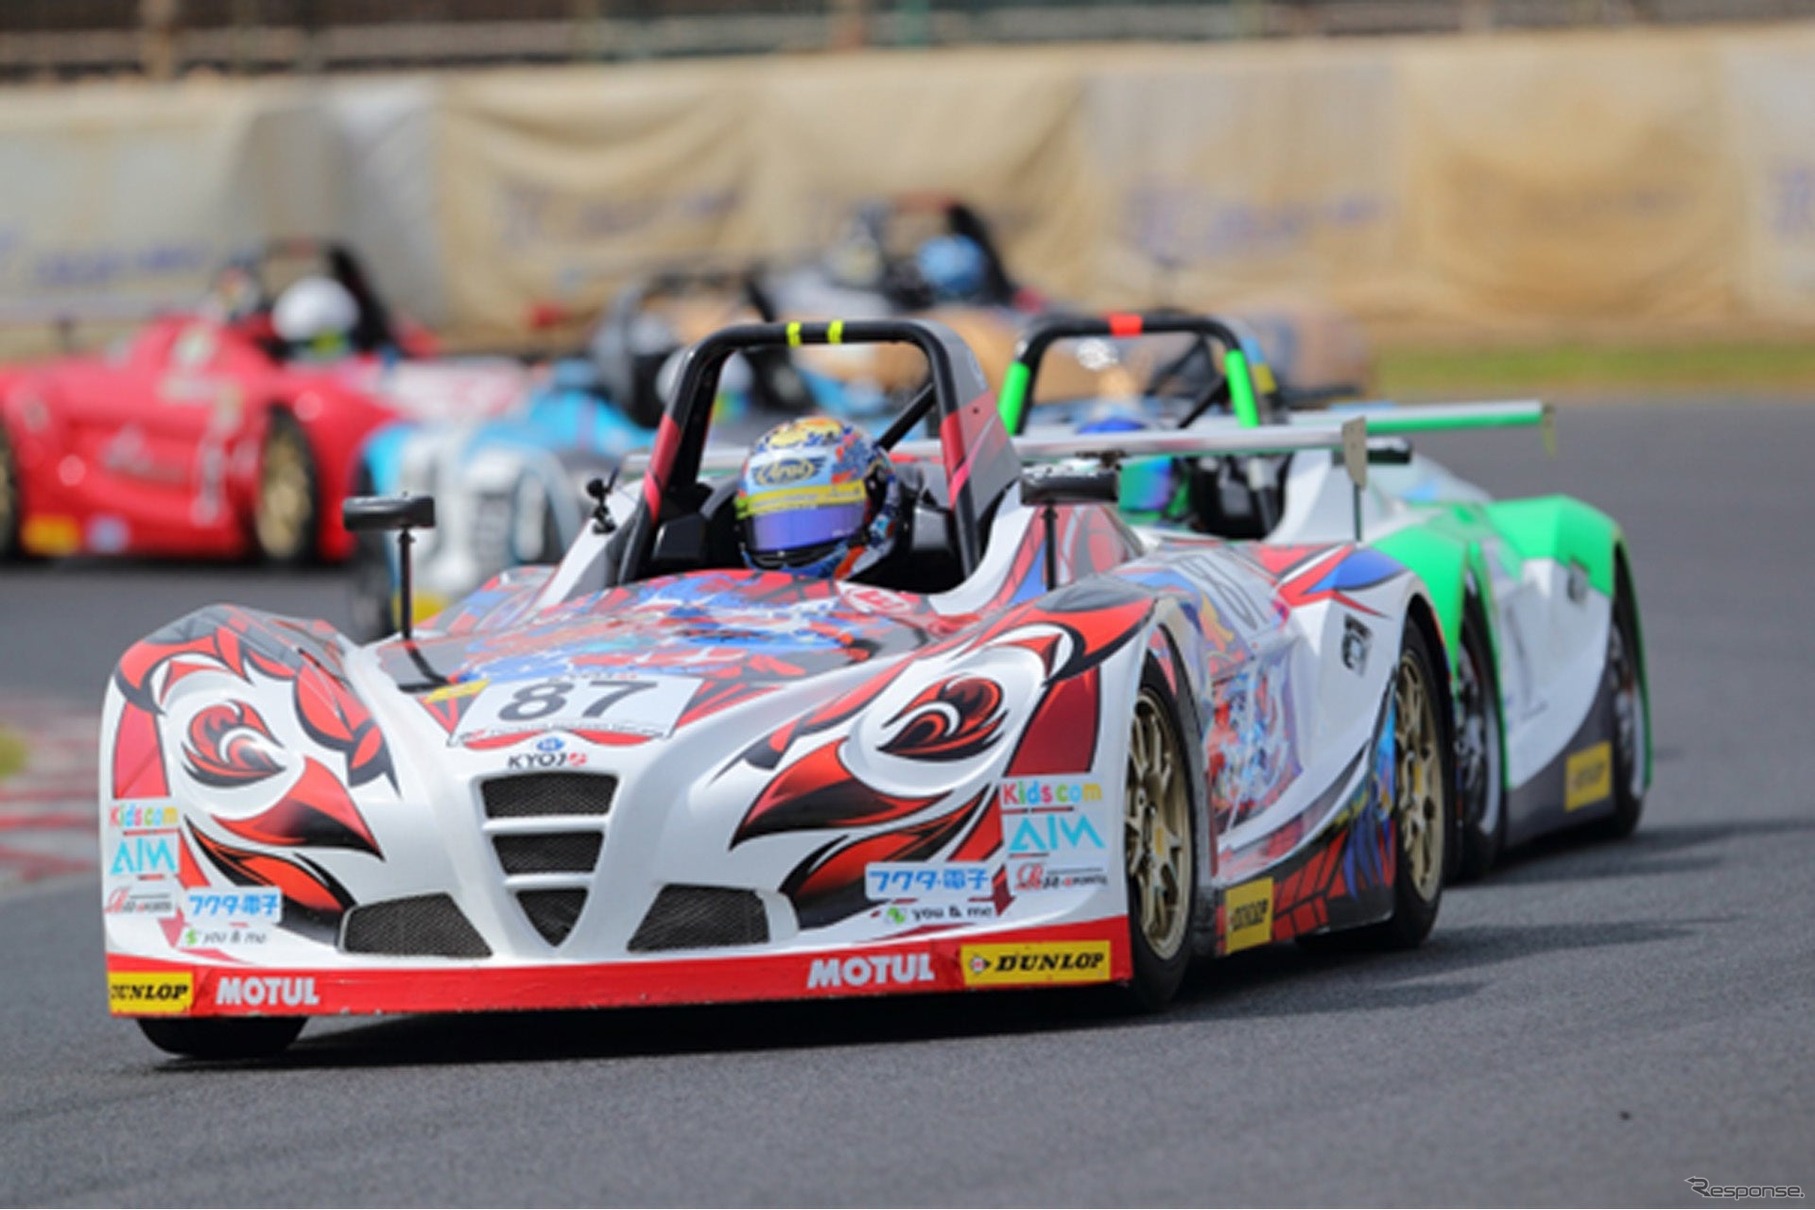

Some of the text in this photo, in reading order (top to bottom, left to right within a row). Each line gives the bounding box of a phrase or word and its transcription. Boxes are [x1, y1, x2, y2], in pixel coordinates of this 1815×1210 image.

[497, 680, 658, 721] 87
[911, 905, 993, 922] you & me
[807, 953, 935, 989] MOTUL
[995, 952, 1104, 973] DUNLOP
[216, 976, 320, 1006] MOTUL
